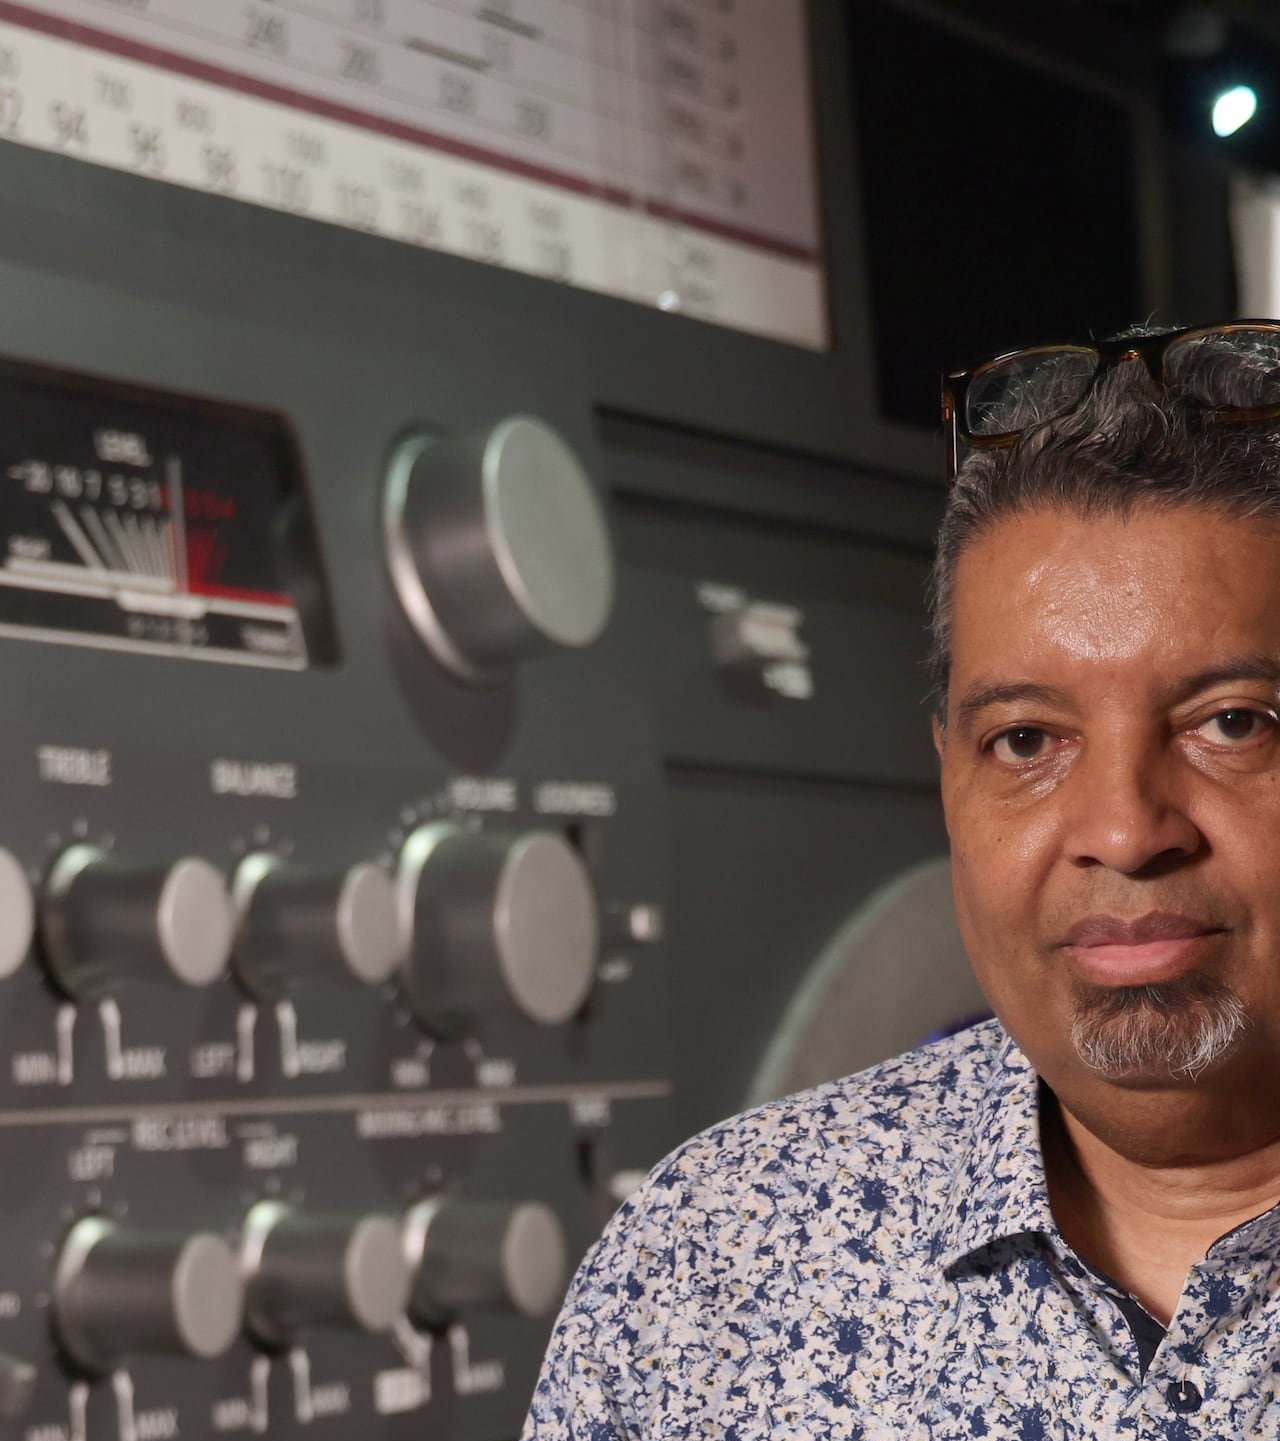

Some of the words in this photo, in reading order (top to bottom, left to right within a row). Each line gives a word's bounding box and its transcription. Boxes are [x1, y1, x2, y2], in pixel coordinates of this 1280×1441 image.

[37, 745, 112, 786] TREBLE
[211, 758, 297, 800] BALANCE
[12, 1053, 56, 1086] MIN
[121, 1047, 166, 1080] MAX
[192, 1043, 234, 1078] LEFT
[68, 1145, 115, 1181] LEFT
[135, 1408, 180, 1441] MAX
